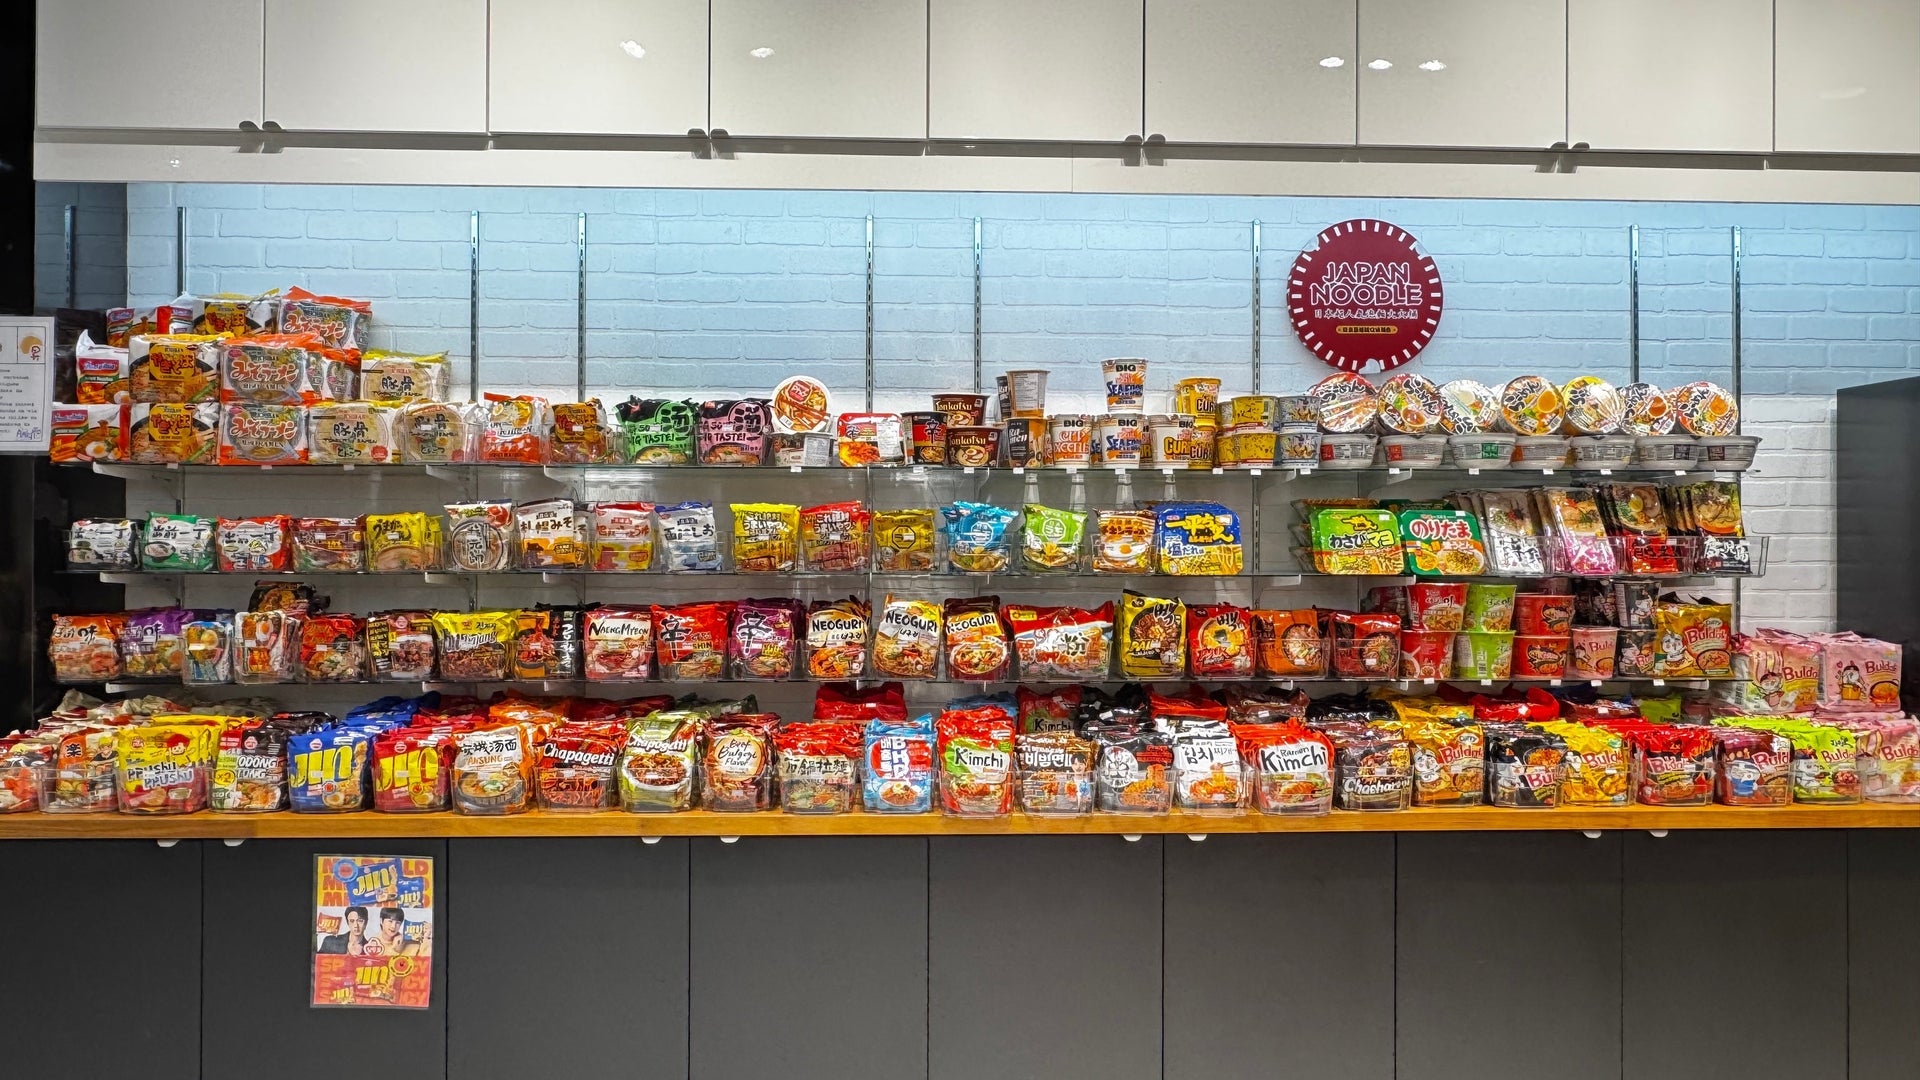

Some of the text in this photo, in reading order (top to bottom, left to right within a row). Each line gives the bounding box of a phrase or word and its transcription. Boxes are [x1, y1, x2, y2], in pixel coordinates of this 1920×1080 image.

[1322, 261, 1410, 284] JAPAN
[1309, 282, 1423, 306] NOODLE
[230, 361, 299, 382] みそラーメン
[1115, 364, 1136, 372] BIG
[1402, 378, 1439, 415] らーめん
[1513, 380, 1541, 413] らーめん
[230, 416, 297, 440] みそラーメン
[1063, 419, 1084, 428] BIG
[1118, 419, 1138, 428] BIG
[151, 526, 207, 540] 出前一丁
[1410, 518, 1473, 539] のりたま
[812, 618, 862, 632] NEOGURI
[885, 610, 938, 633] NEOGURI
[946, 614, 996, 634] NEOGURI
[660, 614, 692, 661] 辛
[737, 610, 773, 656] 辛
[1685, 628, 1728, 645] Buldak
[692, 641, 713, 650] SHIN
[1034, 718, 1071, 732] Kimchi
[627, 734, 687, 753] Chapagetti
[729, 738, 751, 748] Beef
[1280, 746, 1310, 757] Ramen
[237, 756, 279, 768] ODONG
[543, 742, 616, 767] Chapagetti
[724, 757, 749, 766] Flavor
[954, 747, 1003, 768] Kimchi
[1260, 746, 1327, 773] Kimchi
[783, 757, 849, 777] 石鍋拉麵
